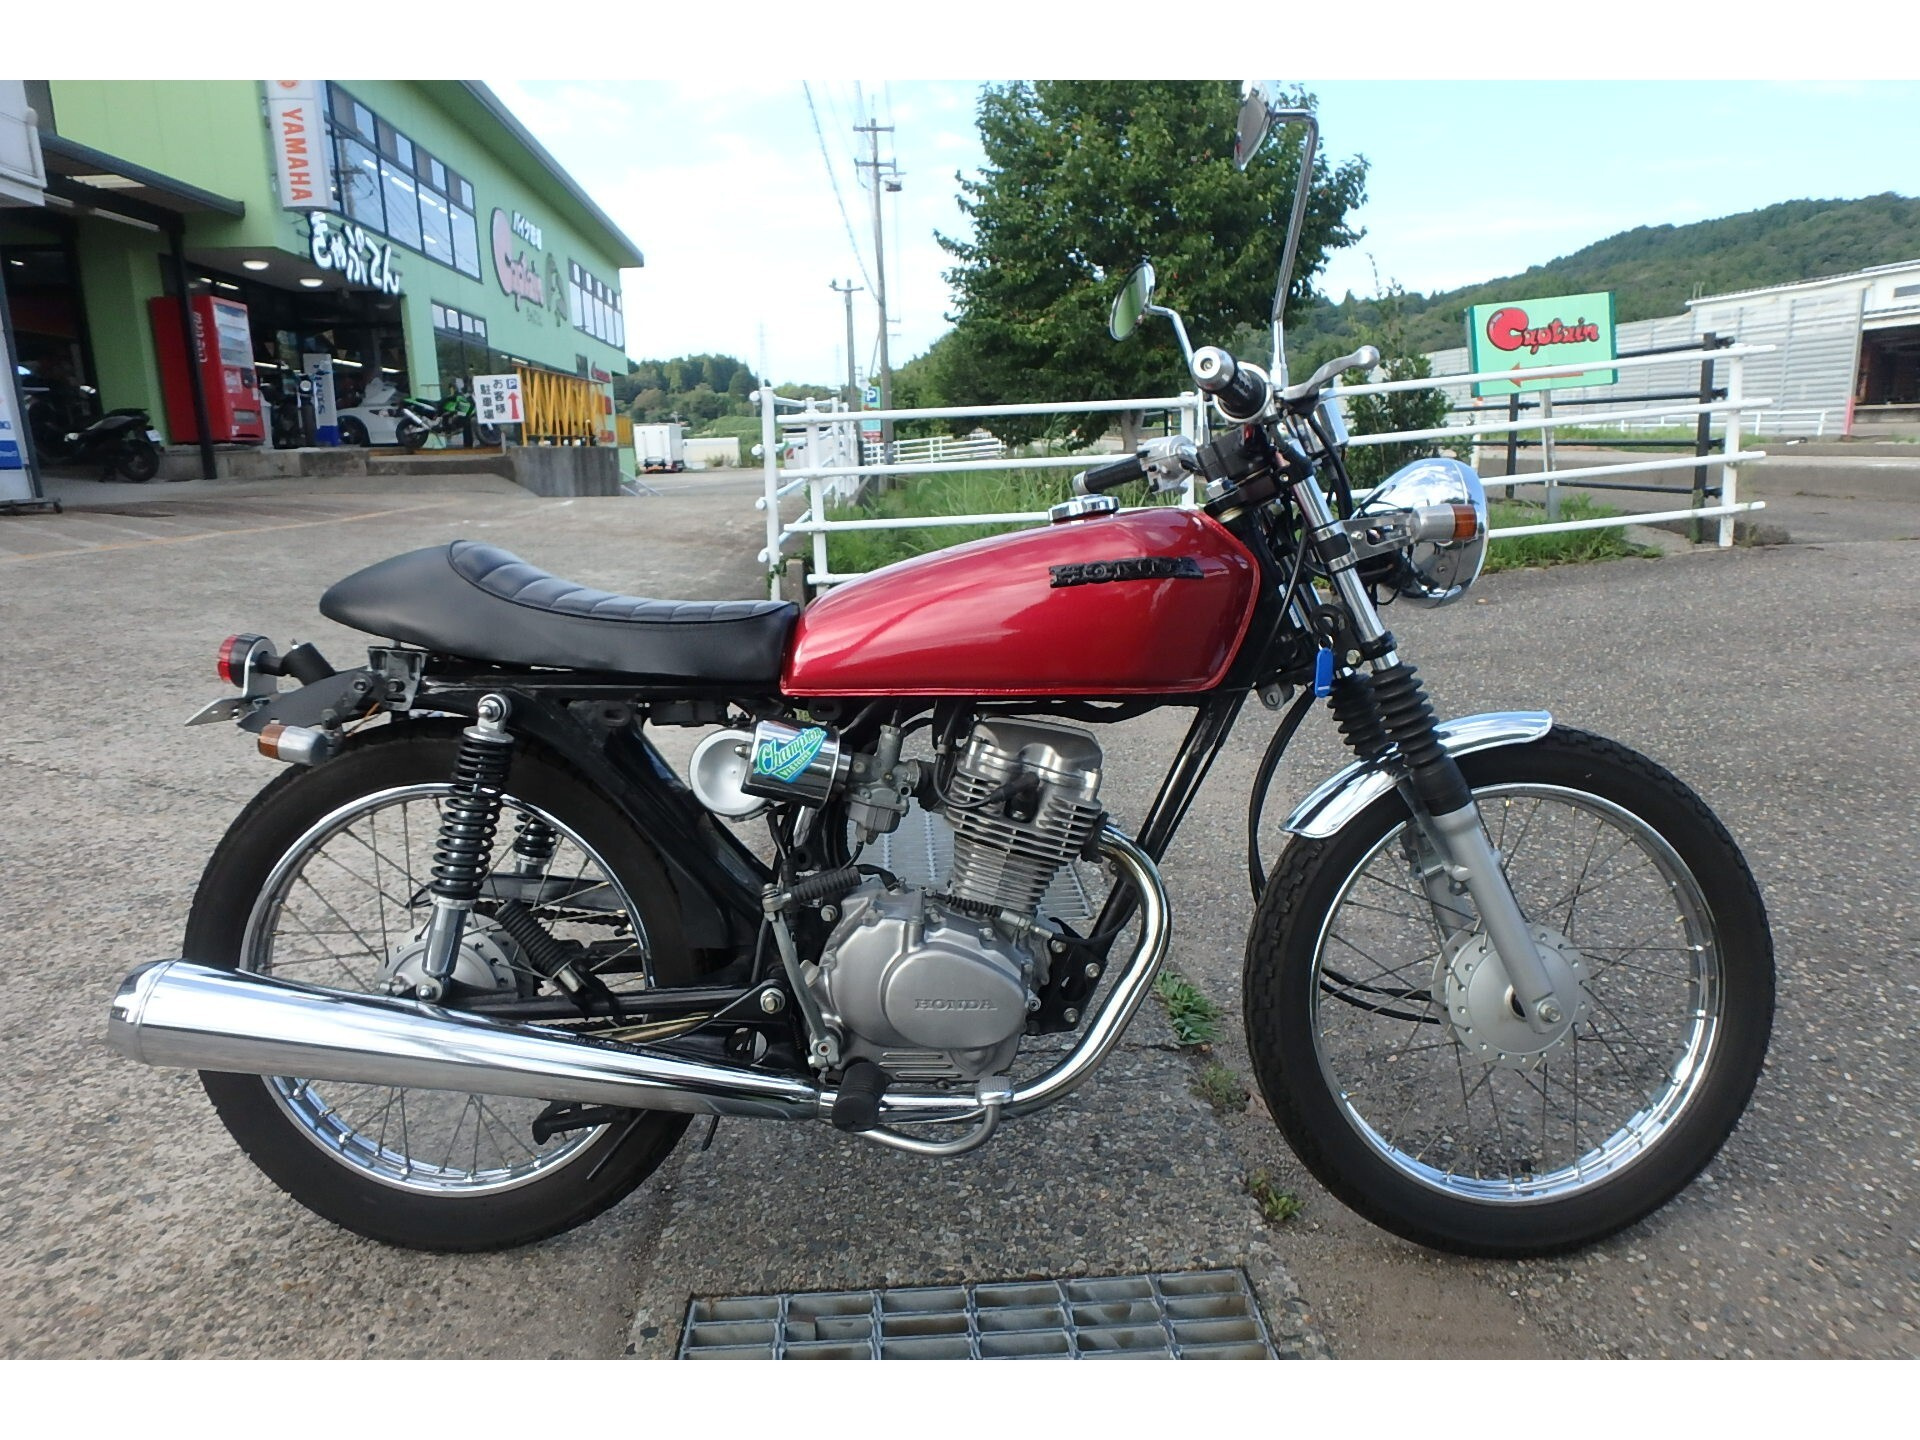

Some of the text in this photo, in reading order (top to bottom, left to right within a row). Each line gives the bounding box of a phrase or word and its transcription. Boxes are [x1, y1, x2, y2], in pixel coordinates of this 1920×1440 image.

[282, 108, 313, 201] YAMAHA
[311, 211, 400, 296] きゃぷてん
[1486, 307, 1600, 355] Captain
[493, 379, 506, 414] お客様
[753, 727, 827, 775] Champion
[914, 998, 998, 1011] HONDA
